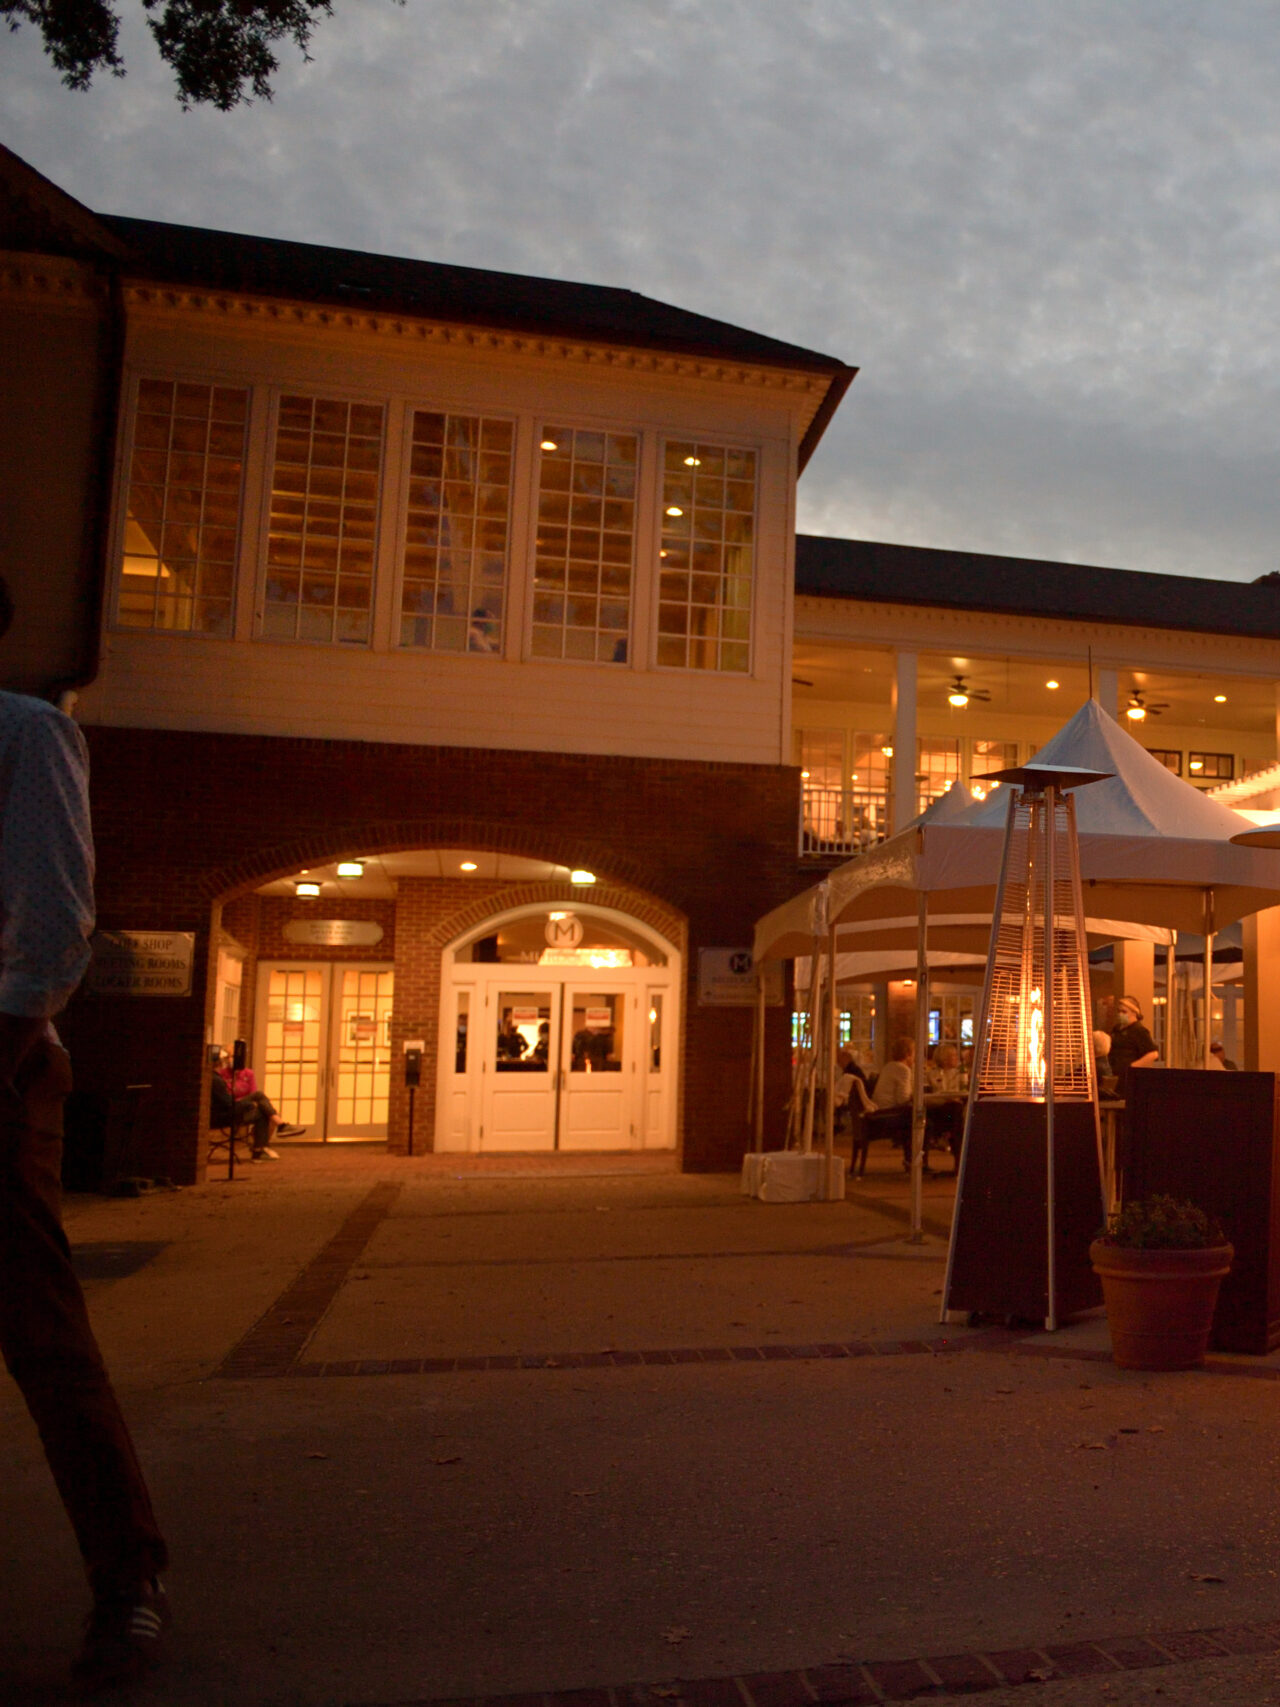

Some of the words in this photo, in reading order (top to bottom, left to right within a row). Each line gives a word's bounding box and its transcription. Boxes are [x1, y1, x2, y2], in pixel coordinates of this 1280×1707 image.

[553, 922, 575, 941] M
[143, 938, 172, 951] SHOP
[147, 957, 186, 970] ROOMS
[143, 976, 183, 989] ROOMS
